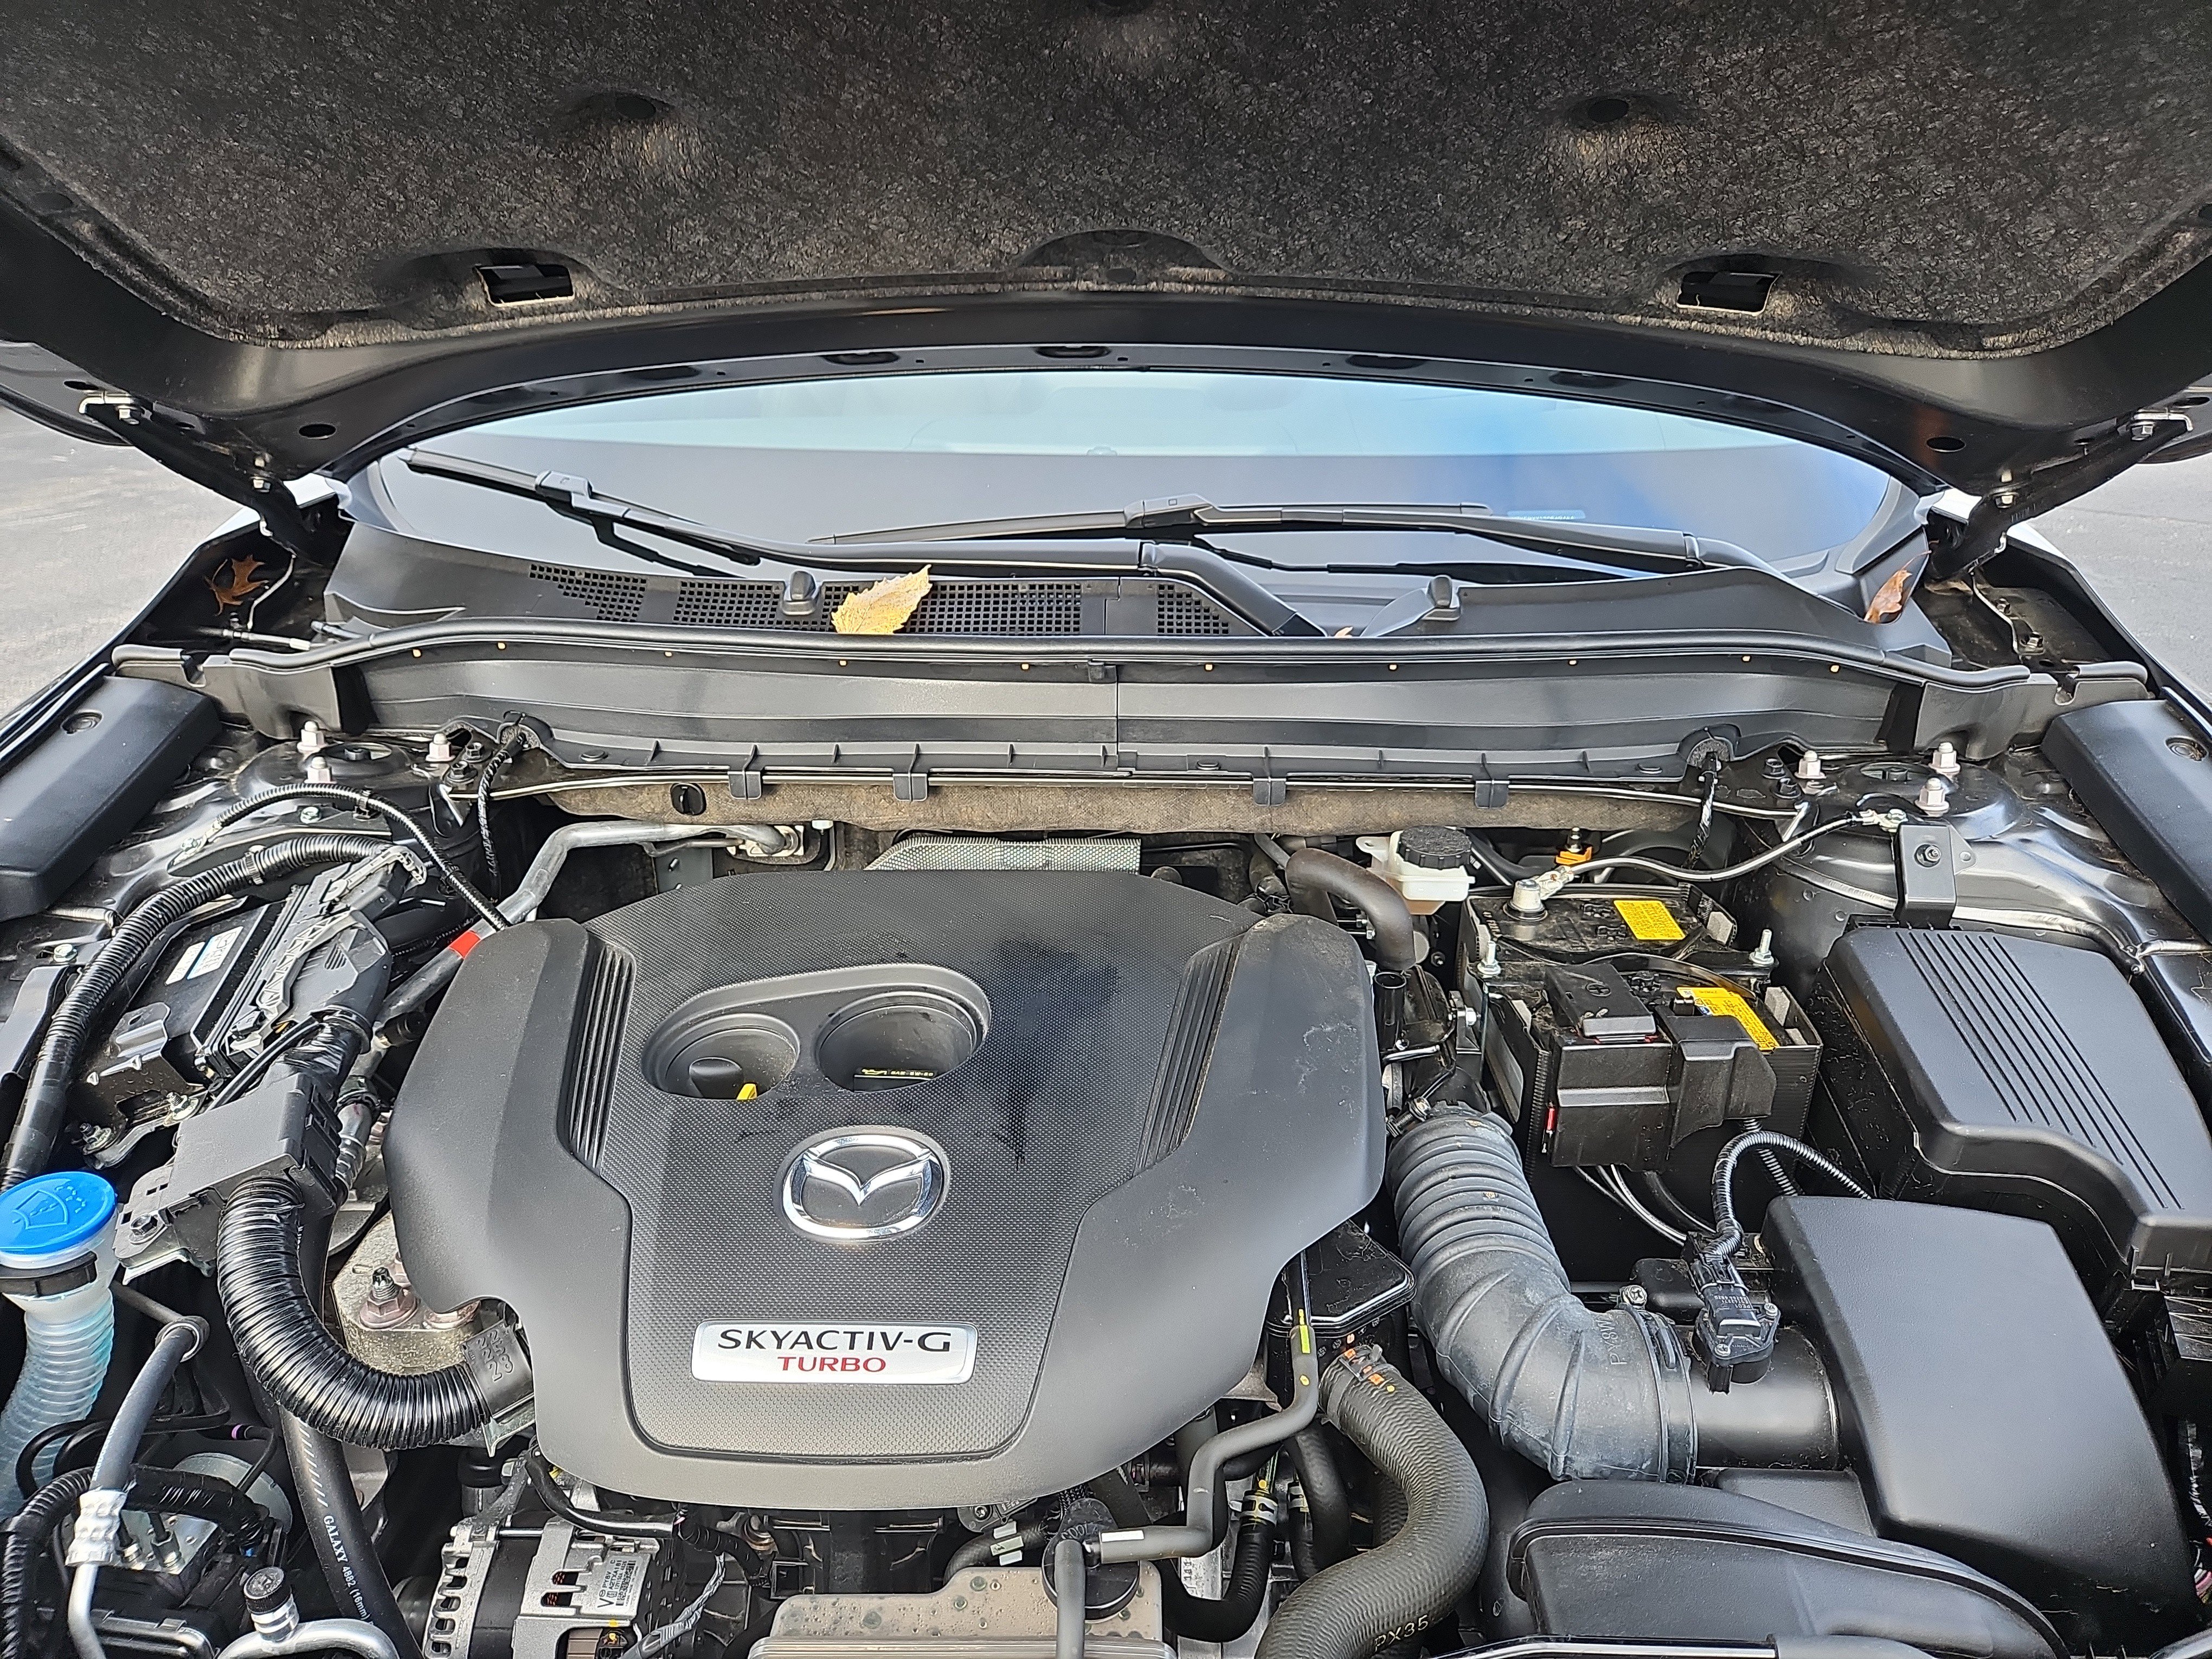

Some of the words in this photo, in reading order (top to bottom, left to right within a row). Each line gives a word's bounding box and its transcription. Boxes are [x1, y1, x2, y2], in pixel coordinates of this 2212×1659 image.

[718, 1329, 951, 1352] SKYACTIV-G
[1595, 1319, 1628, 1365] PY8W
[777, 1356, 886, 1372] TURBO
[324, 1514, 350, 1564] GALAXY
[343, 1565, 357, 1589] 4882
[350, 1588, 370, 1622] (16mm)
[1374, 1614, 1429, 1652] PX35
